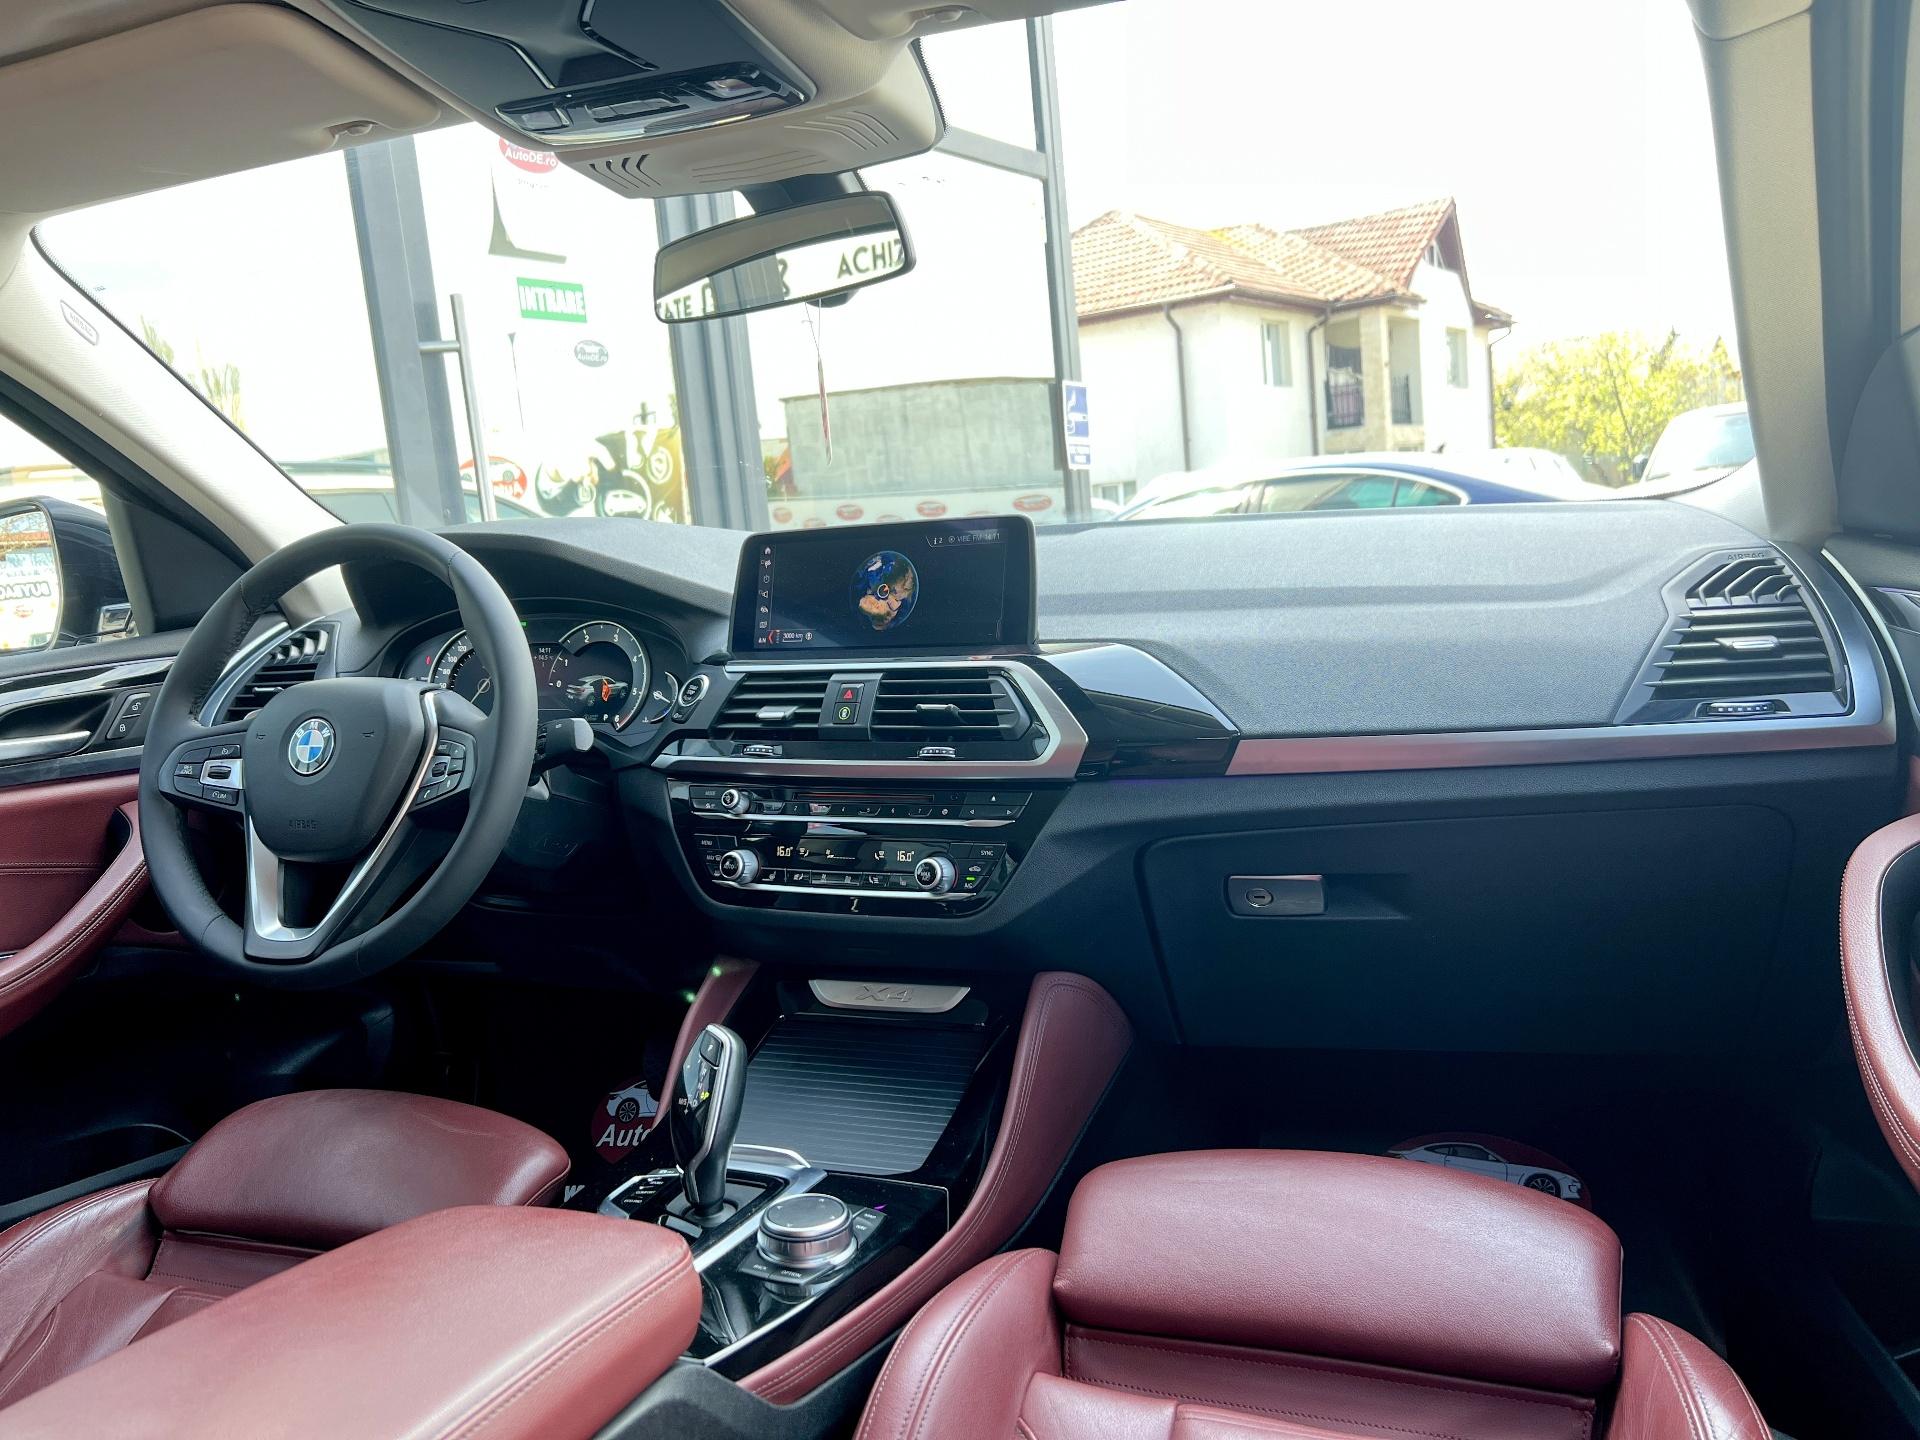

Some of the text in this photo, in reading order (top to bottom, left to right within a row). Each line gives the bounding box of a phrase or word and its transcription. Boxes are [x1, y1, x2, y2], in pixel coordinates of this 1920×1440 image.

[505, 147, 557, 167] AutoDE.ro
[518, 285, 585, 315] INTRARE
[584, 635, 590, 643] 2
[613, 634, 619, 642] 3
[556, 680, 562, 688] 0
[632, 687, 637, 695] 5
[603, 714, 609, 722] P
[614, 714, 620, 723] 6
[856, 984, 913, 1003] X4
